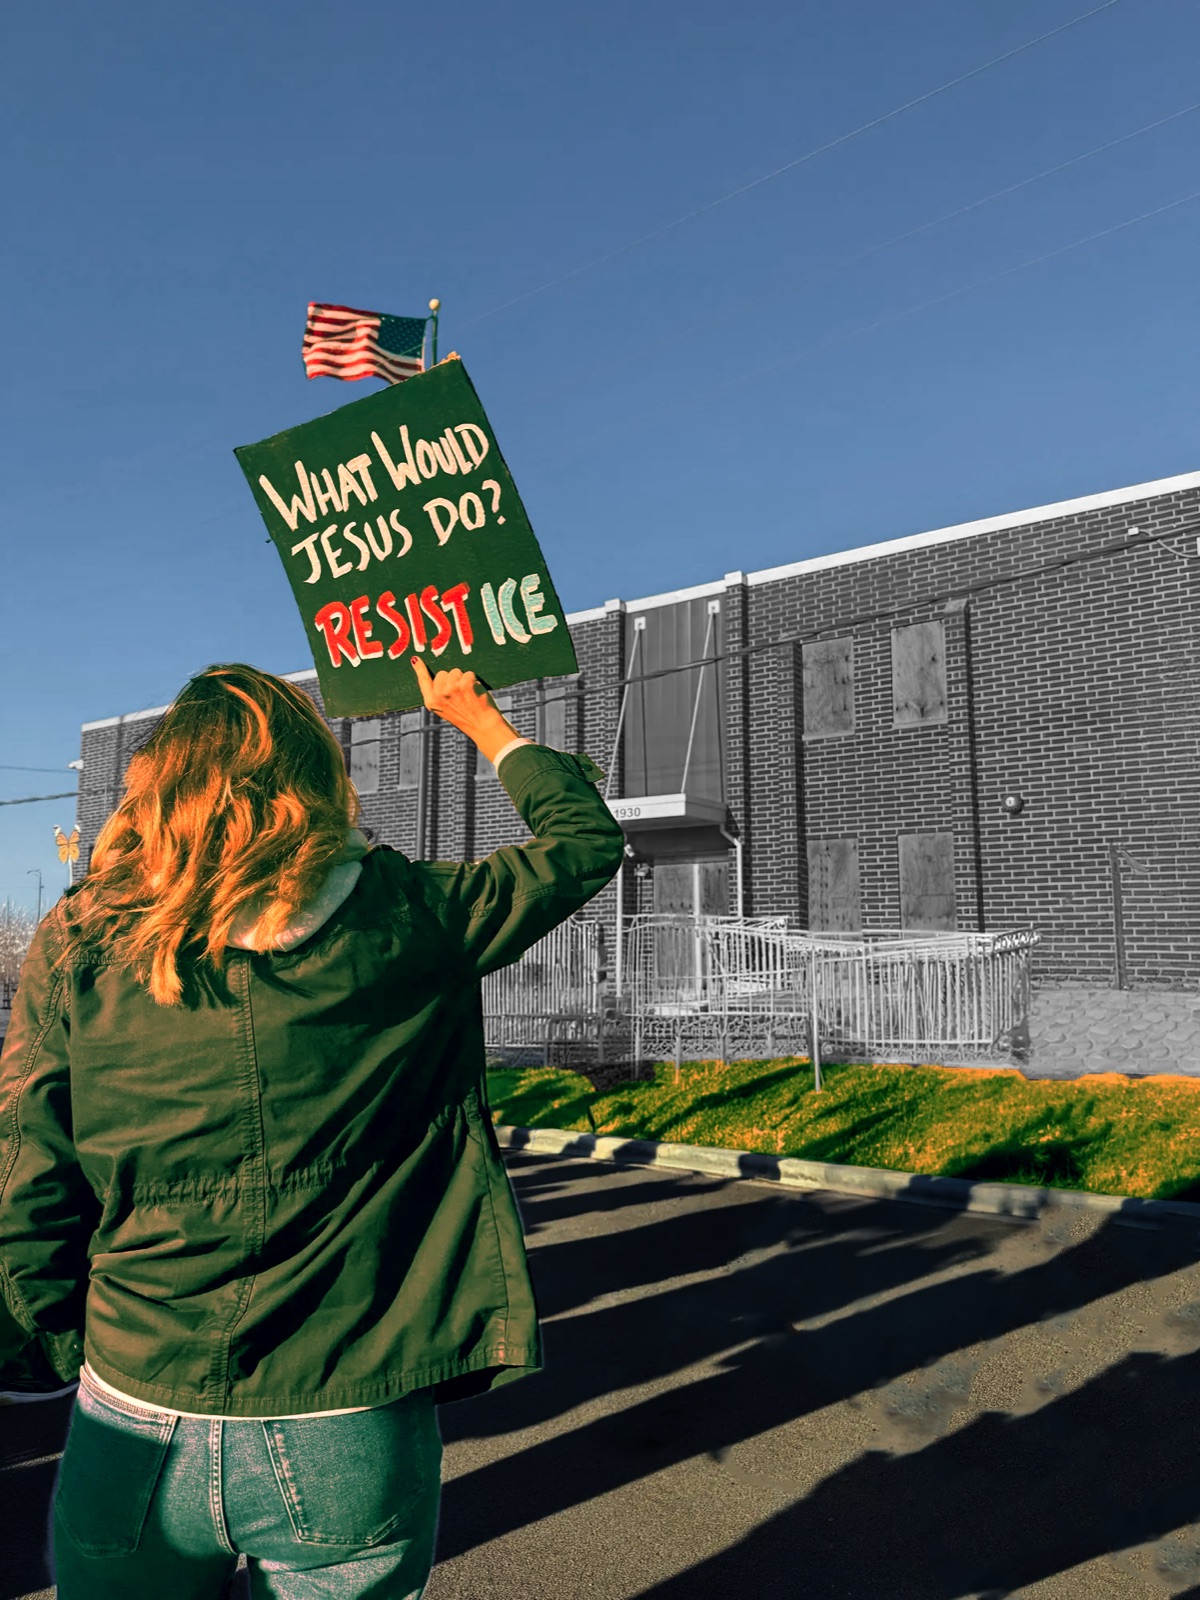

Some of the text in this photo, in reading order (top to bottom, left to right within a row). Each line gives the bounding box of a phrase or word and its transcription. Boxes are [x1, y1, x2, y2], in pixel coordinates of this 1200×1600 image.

[259, 424, 489, 531] WHAT WOULD
[291, 479, 506, 584] JESUS DO?
[315, 573, 558, 668] RESIST ICE
[613, 807, 641, 819] 1930
